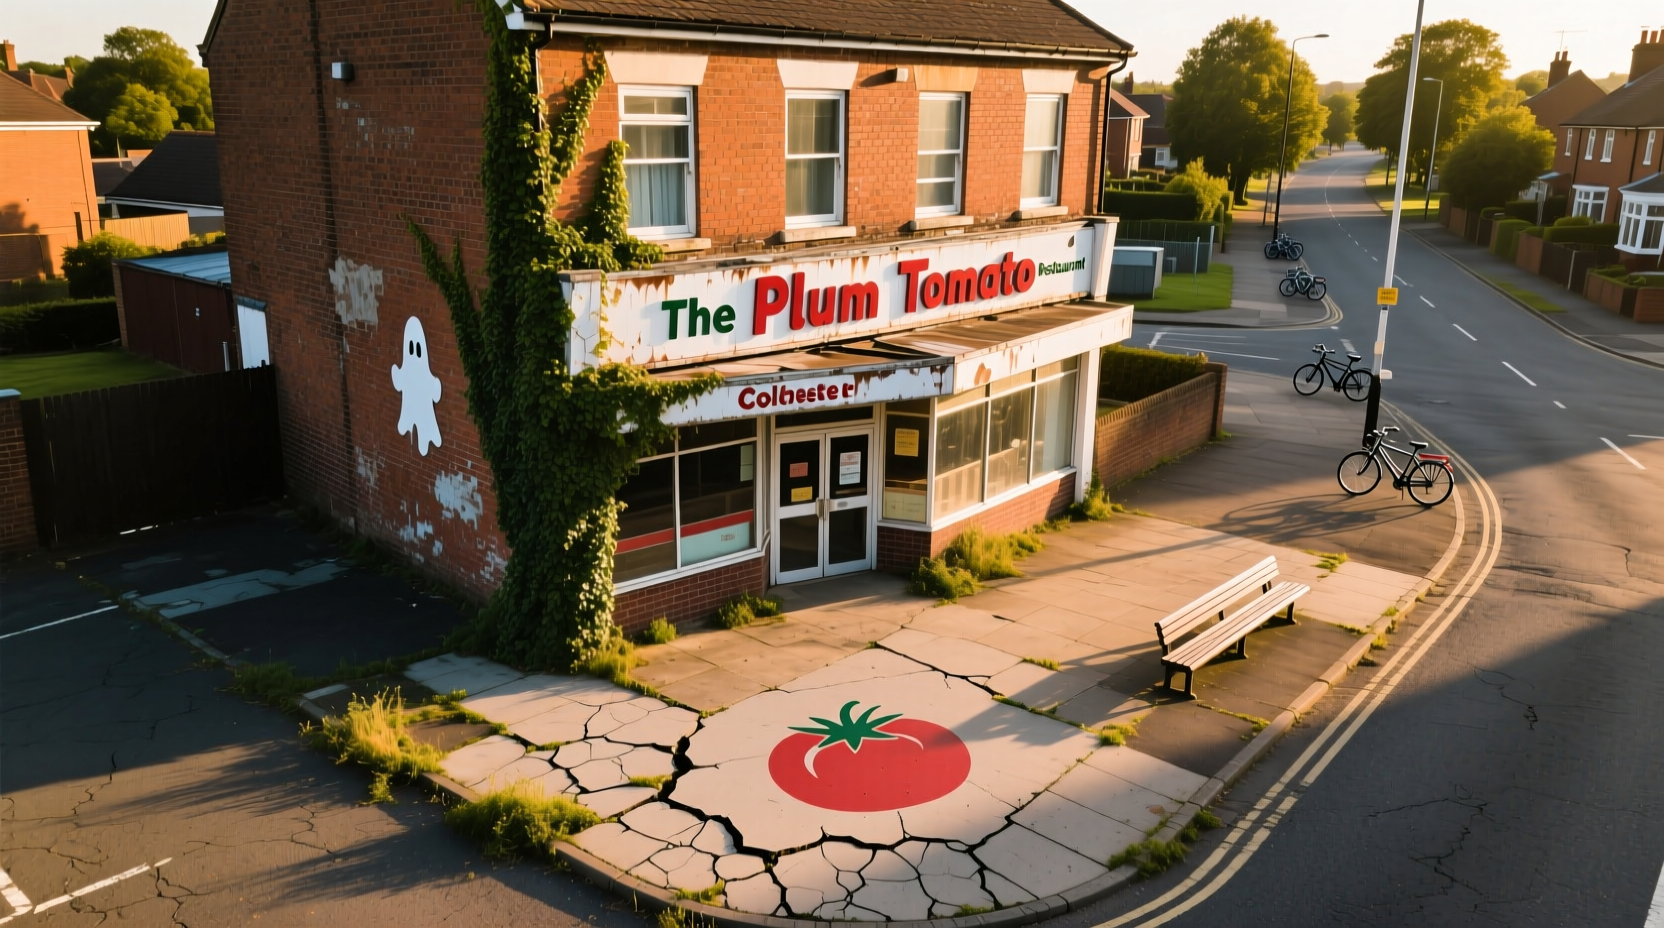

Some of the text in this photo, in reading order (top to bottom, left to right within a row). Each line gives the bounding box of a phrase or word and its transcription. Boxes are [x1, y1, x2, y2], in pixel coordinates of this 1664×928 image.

[661, 297, 736, 340] The
[752, 271, 880, 336] Plum
[897, 251, 1037, 314] Tomato
